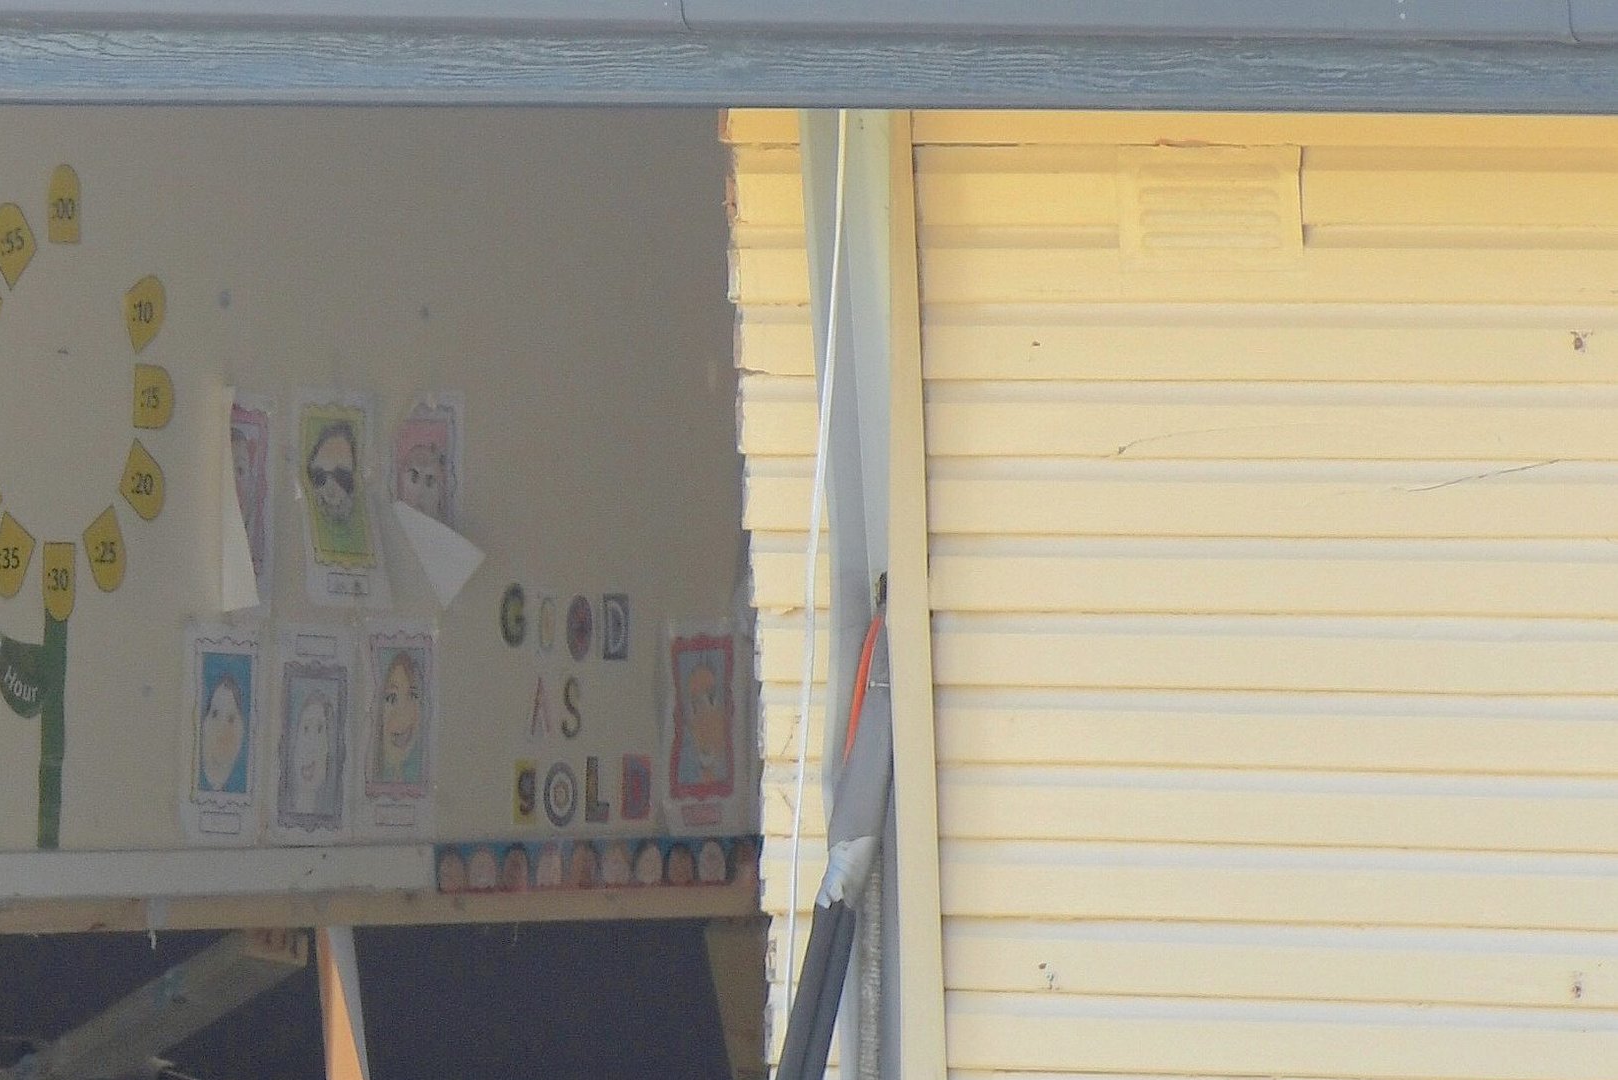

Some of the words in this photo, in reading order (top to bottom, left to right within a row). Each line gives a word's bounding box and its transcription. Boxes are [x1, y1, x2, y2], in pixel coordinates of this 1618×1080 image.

[0, 227, 25, 257] :55
[132, 299, 154, 324] :10
[131, 471, 154, 496] :20
[94, 540, 117, 564] :25
[47, 567, 70, 592] :30
[500, 581, 631, 662] GOOD
[3, 664, 39, 703] Hour
[530, 675, 582, 739] AS
